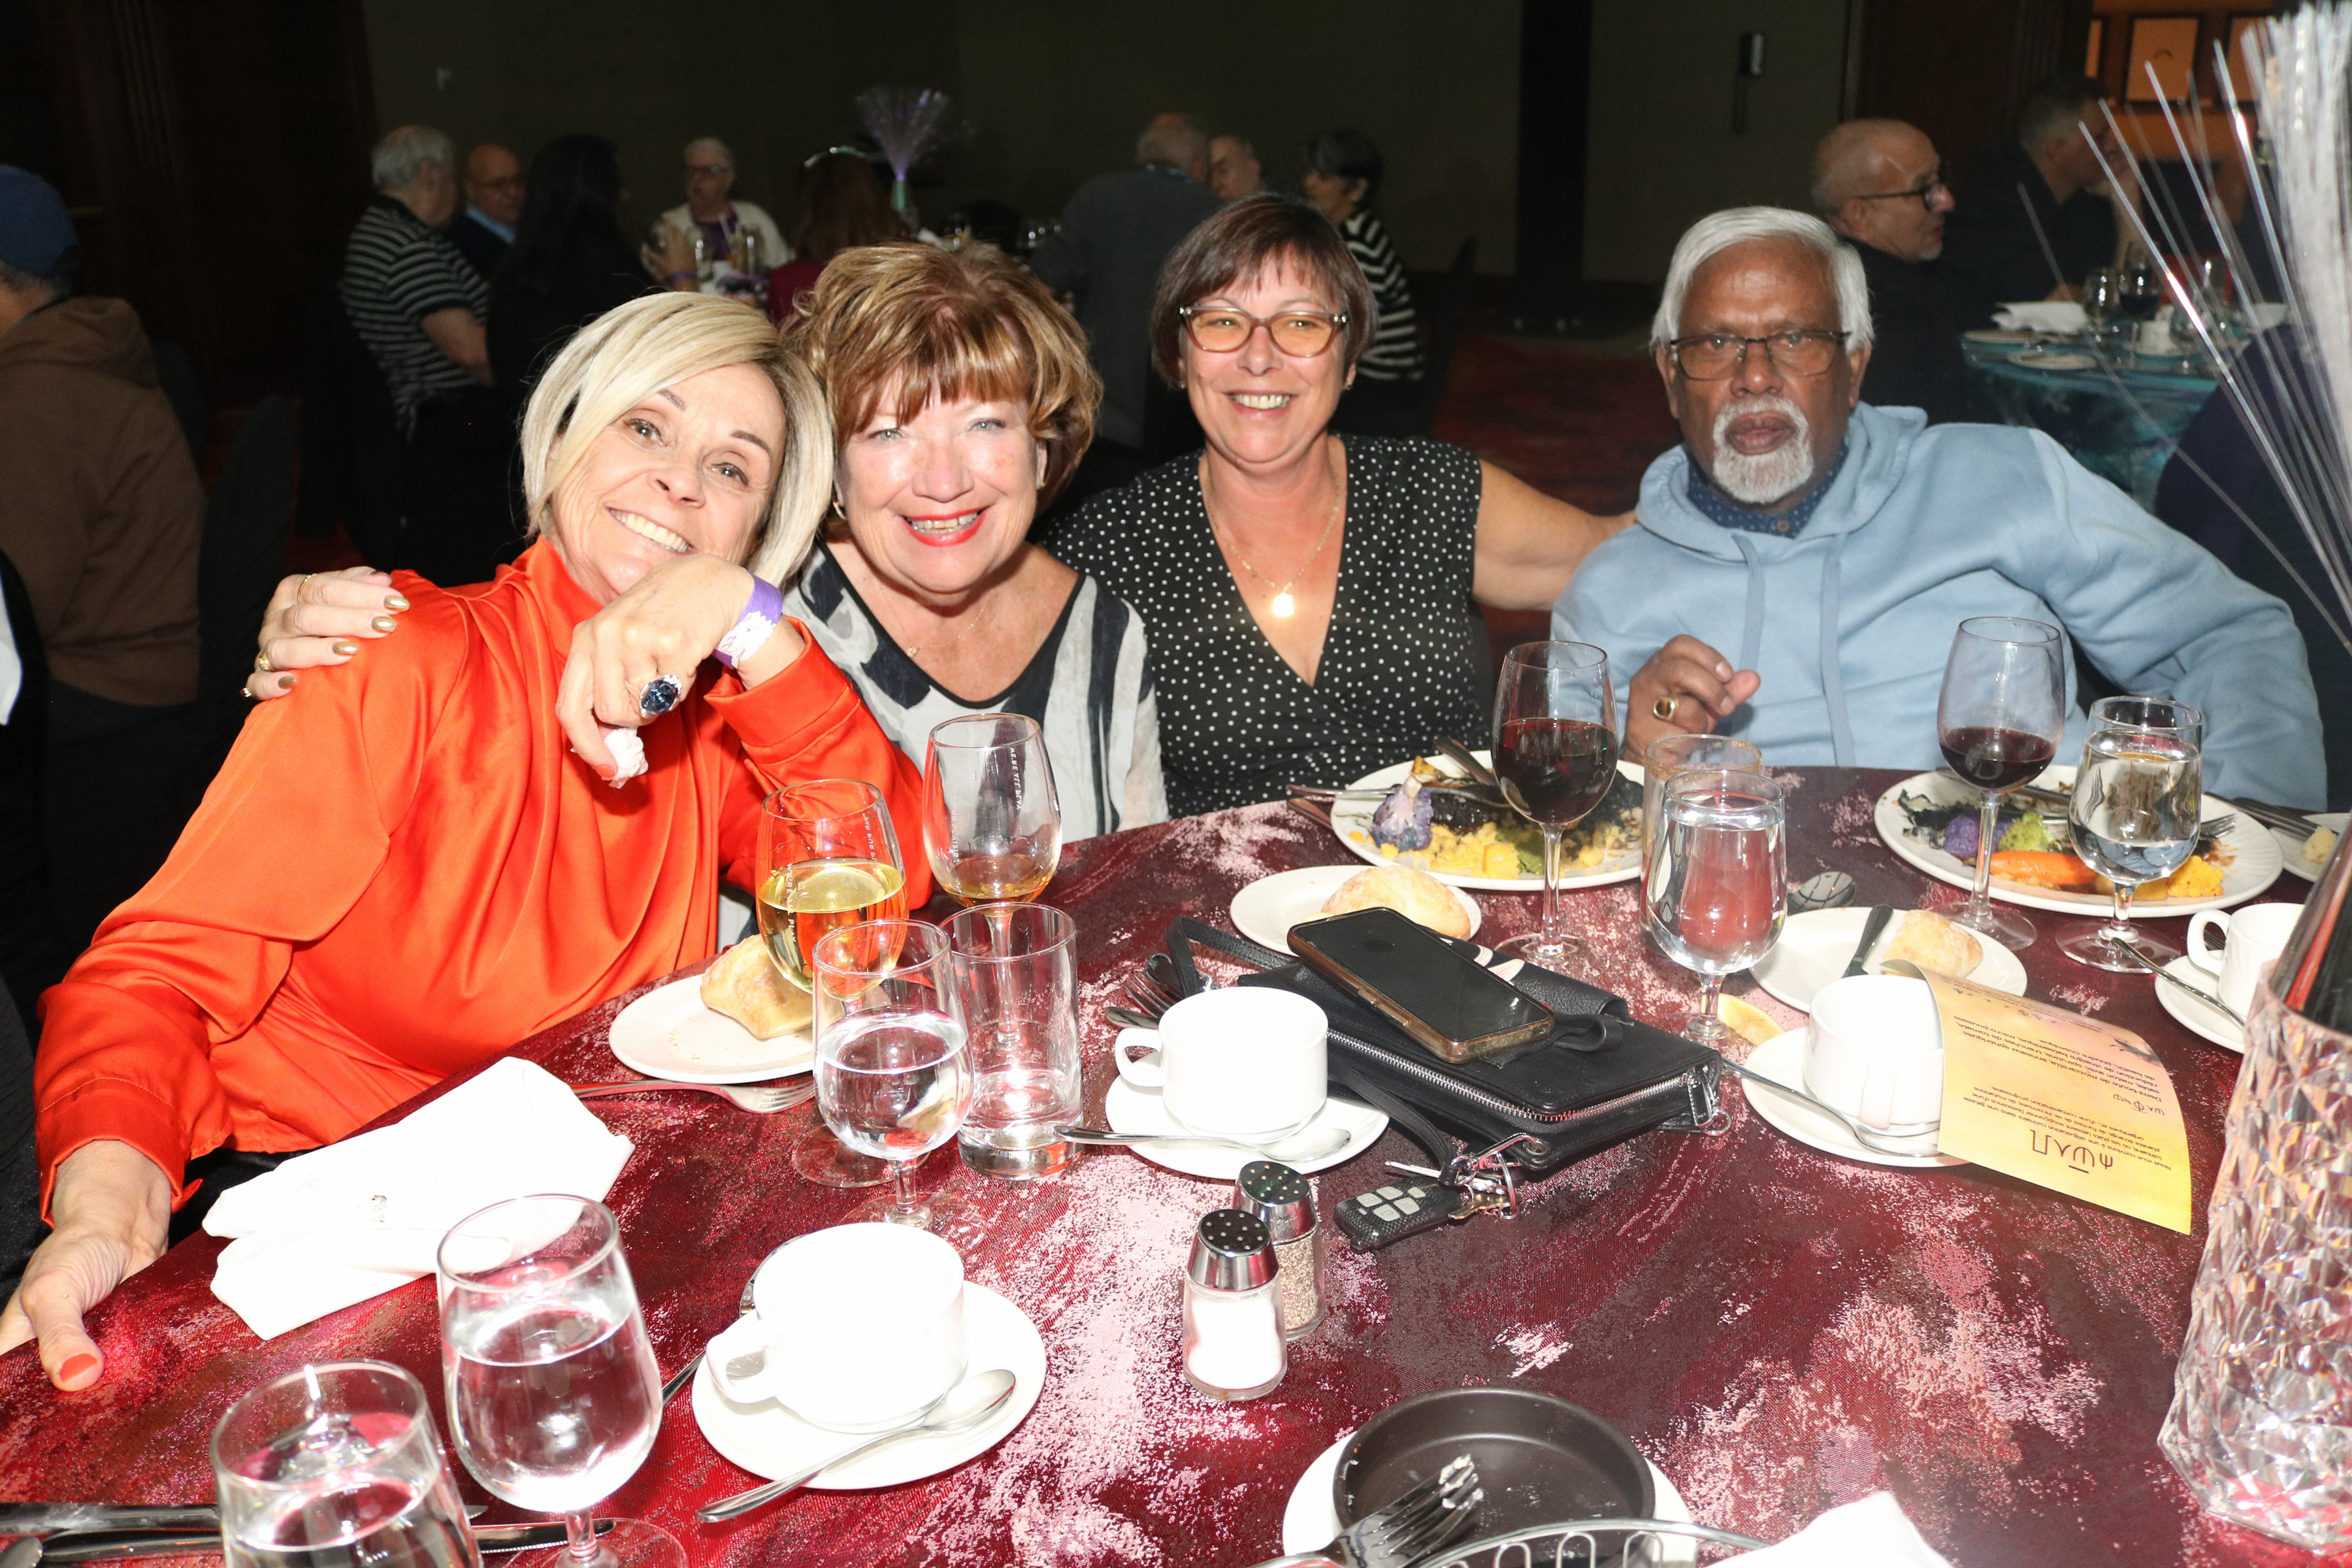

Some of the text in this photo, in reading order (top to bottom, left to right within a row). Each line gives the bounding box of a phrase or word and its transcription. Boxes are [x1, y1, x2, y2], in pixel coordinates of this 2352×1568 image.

[787, 919, 796, 943] PLAY
[1953, 1016, 2016, 1039] micro-pousses
[1956, 1022, 1989, 1037] tomate,
[1963, 1031, 2009, 1050] sphériques
[2004, 1039, 2042, 1054] tranches
[2017, 1036, 2068, 1058] balsamique,
[2039, 1039, 2080, 1054] cosmique
[2011, 1048, 2047, 1062] anneaux
[2044, 1052, 2082, 1068] spiruline,
[2070, 1054, 2102, 1069] vinaigre
[2082, 1053, 2112, 1066] poudre
[2049, 1060, 2097, 1079] mozzarella,
[2113, 1063, 2143, 1077] basilic,
[2106, 1074, 2133, 1085] melon
[2117, 1071, 2157, 1088] réduction
[1974, 1087, 2007, 1101] mutations
[1991, 1086, 2029, 1102] progressive.
[2112, 1083, 2161, 1103] Demi-boule
[2135, 1083, 2159, 1094] salés,
[1963, 1097, 1985, 1107] galaxie
[1972, 1093, 1989, 1102] d'une
[2017, 1102, 2052, 1116] inconnues,
[2031, 1100, 2077, 1118] contamination
[2018, 1116, 2046, 1128] culinaire
[2027, 1111, 2064, 1126] soupçonner
[2079, 1116, 2095, 1124] d'une
[2066, 1124, 2091, 1137] laissent
[2074, 1120, 2097, 1132] formes
[2048, 1126, 2085, 1141] dégustation
[2108, 1132, 2133, 1145] étrange,
[2109, 1126, 2144, 1141] organiques
[2107, 1146, 2135, 1158] convions
[2132, 1147, 2162, 1160] lointaine,
[2154, 1161, 2171, 1170] Nous
